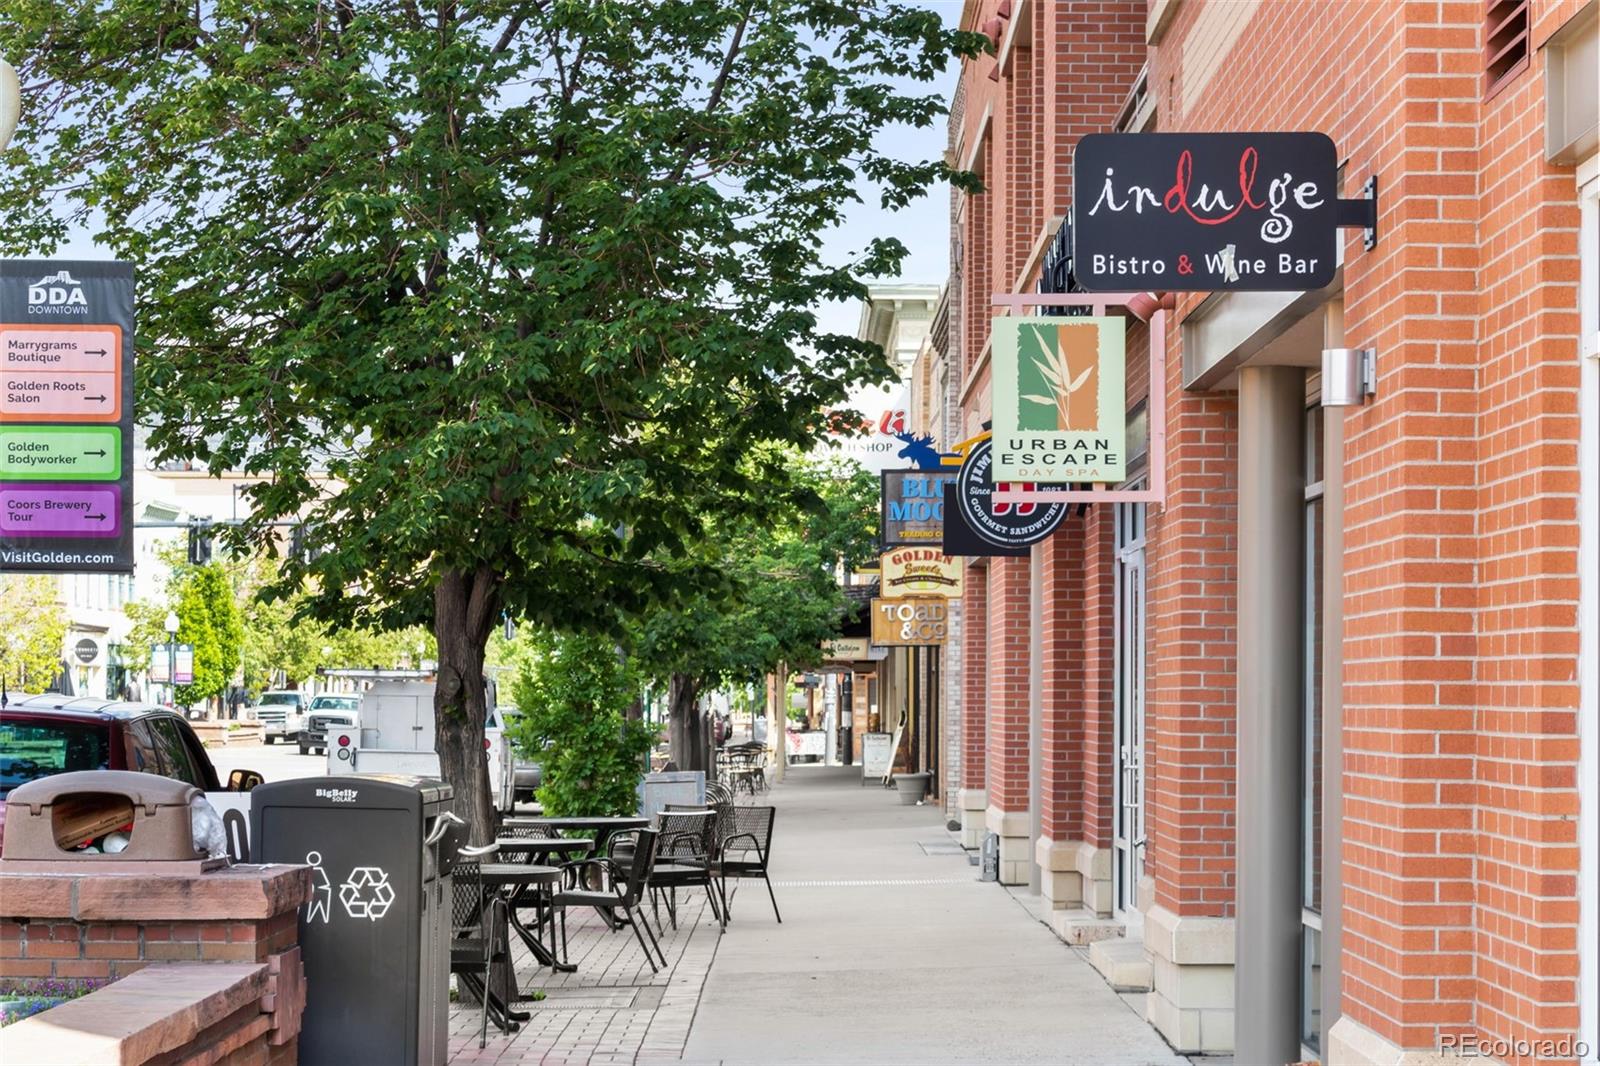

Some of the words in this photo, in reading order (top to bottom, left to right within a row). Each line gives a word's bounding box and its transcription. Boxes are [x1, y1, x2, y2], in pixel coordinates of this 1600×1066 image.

[1088, 146, 1324, 244] indulge
[1092, 254, 1166, 275] Bistro
[1177, 255, 1194, 275] &
[1205, 254, 1267, 275] Wne
[1278, 254, 1319, 275] Bar
[28, 287, 88, 305] DDA
[28, 305, 88, 314] DOWNTOWN
[8, 340, 78, 352] Marrygrams
[8, 352, 61, 364] Boutique
[7, 381, 50, 391] Golden
[53, 381, 86, 391] Roots
[7, 393, 40, 403] Salon
[7, 442, 50, 451] Golden
[1009, 439, 1109, 450] URBAN
[7, 454, 77, 466] Bodyworker
[1001, 453, 1117, 465] ESCAPE
[1018, 468, 1056, 477] DAY
[1065, 468, 1100, 477] SPA
[901, 478, 957, 498] BLU
[969, 486, 991, 496] Since
[7, 500, 41, 510] Coors
[44, 500, 92, 511] Brewery
[888, 501, 944, 522] MOO
[7, 512, 33, 521] Tour
[970, 498, 1008, 534] GOURMET
[1009, 502, 1060, 535] SANDWICHE
[1, 551, 114, 564] VisitGolden.com
[892, 550, 953, 566] GOLDEN
[315, 788, 358, 798] BigBelly
